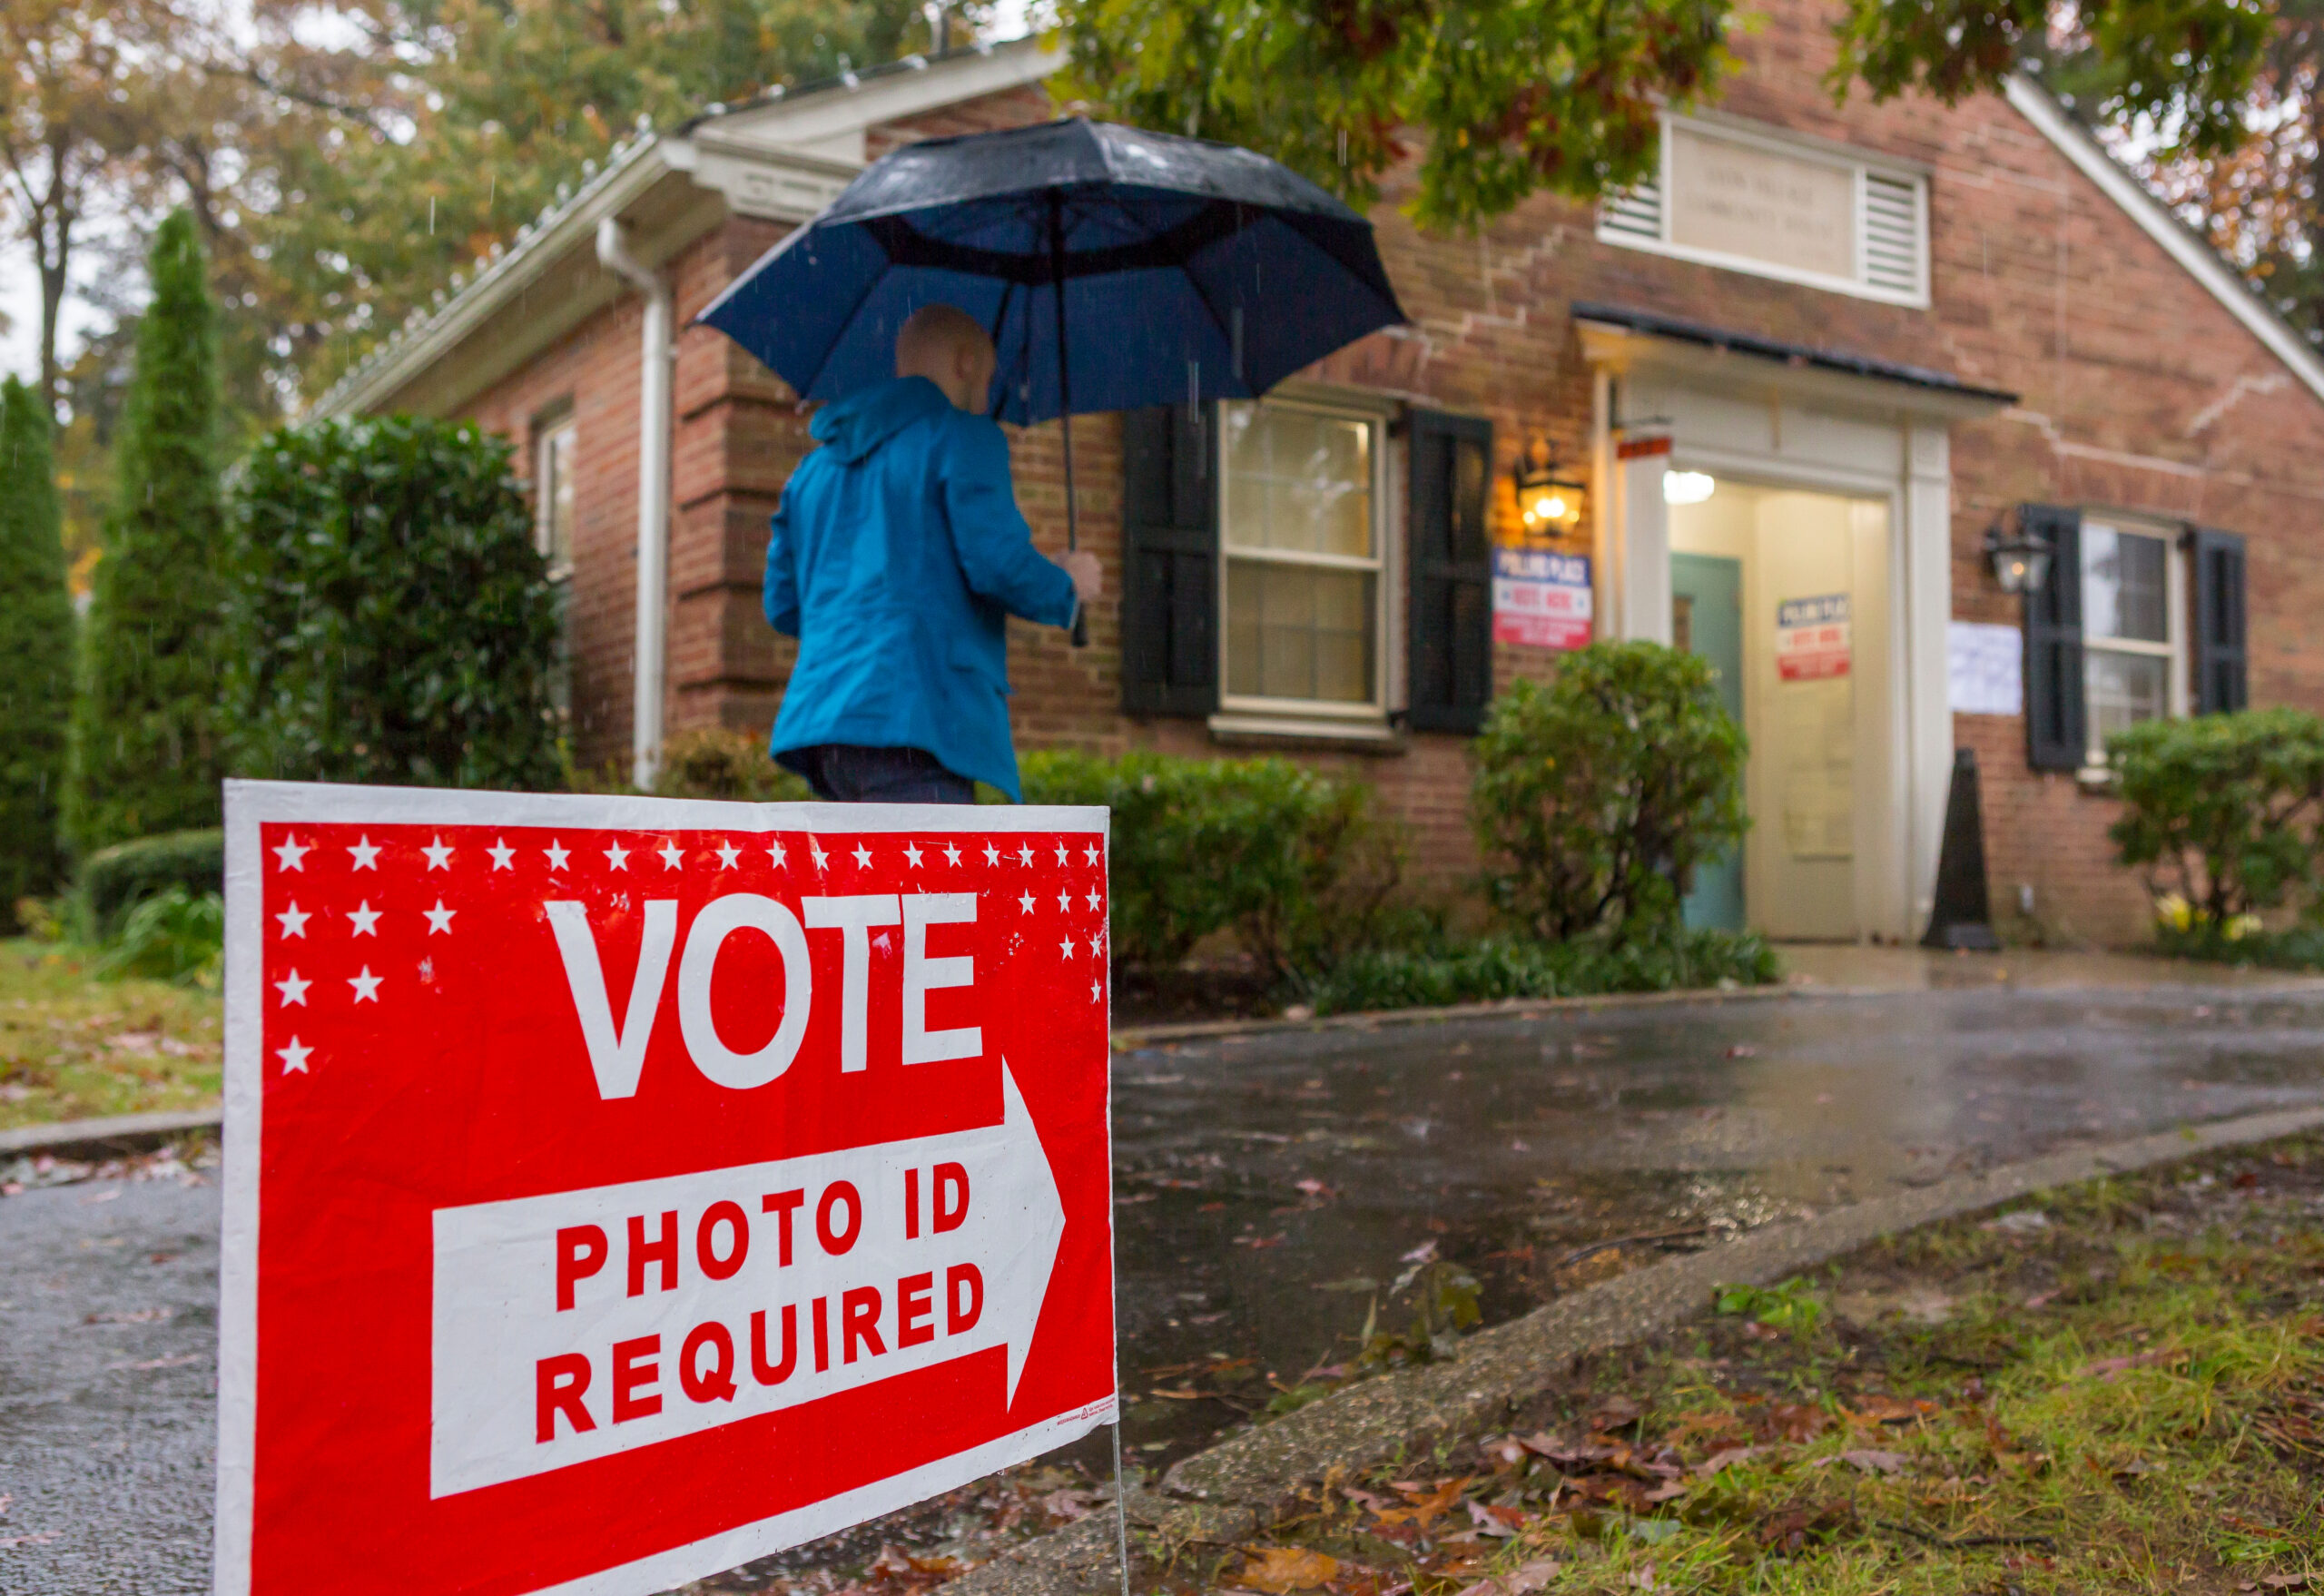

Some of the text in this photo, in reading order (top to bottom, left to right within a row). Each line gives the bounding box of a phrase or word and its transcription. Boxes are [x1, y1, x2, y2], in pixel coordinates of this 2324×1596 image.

[544, 892, 983, 1100] VOTE
[556, 1161, 970, 1313] PHOTO ID
[536, 1263, 984, 1444] REQUIRED
